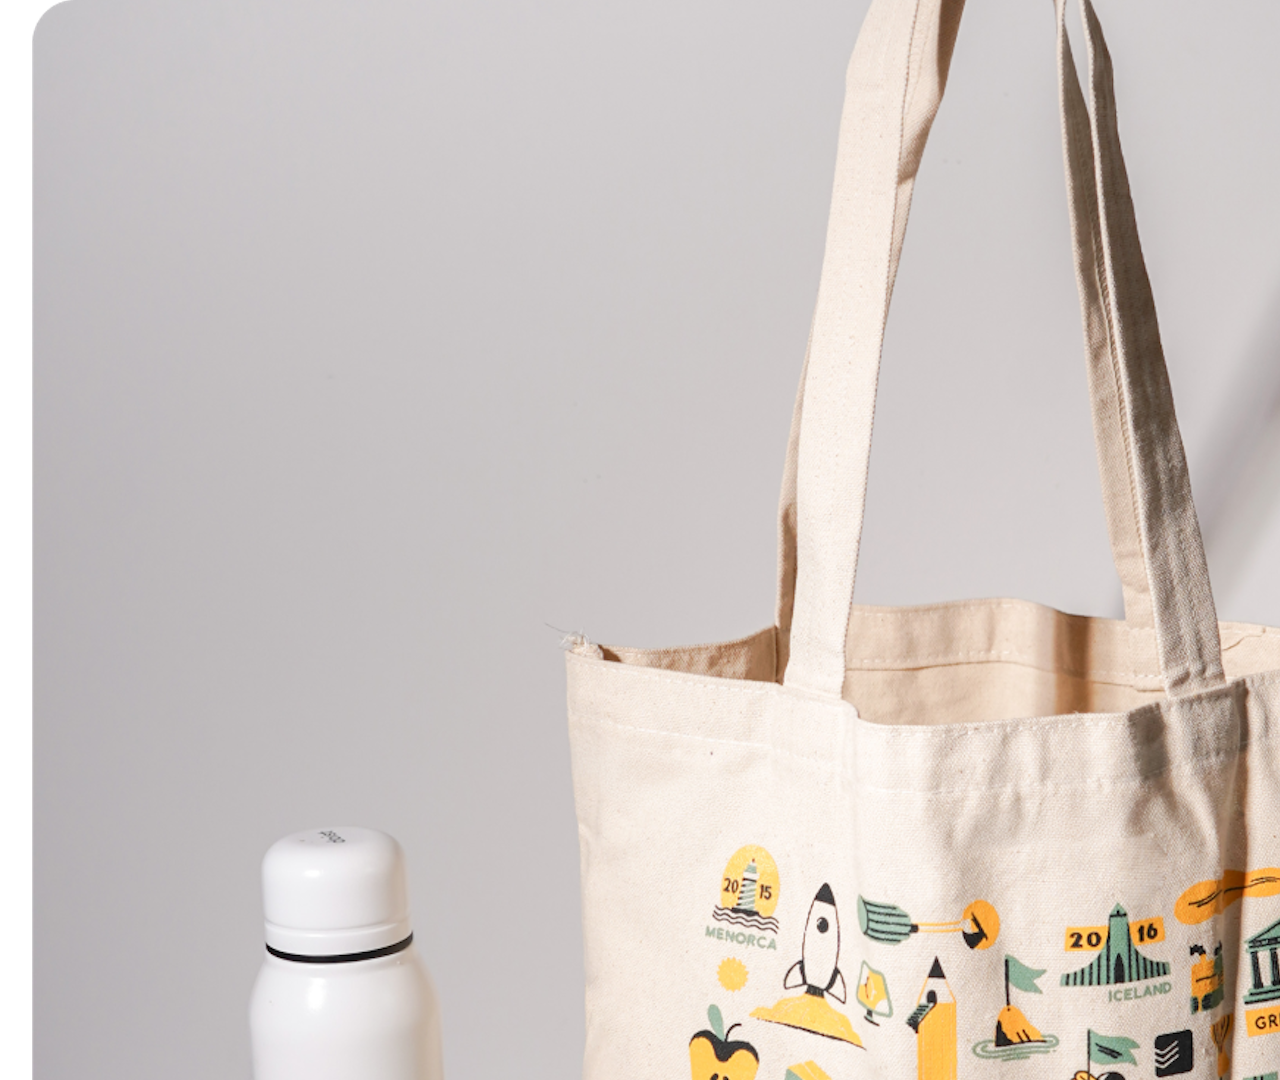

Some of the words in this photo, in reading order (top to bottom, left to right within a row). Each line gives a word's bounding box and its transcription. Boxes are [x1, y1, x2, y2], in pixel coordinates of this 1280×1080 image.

[723, 877, 739, 894] 20
[760, 883, 772, 900] 15
[705, 925, 777, 951] MENORCA
[1069, 931, 1102, 949] 20
[1138, 922, 1158, 943] 16
[1108, 982, 1172, 1003] ICELAND
